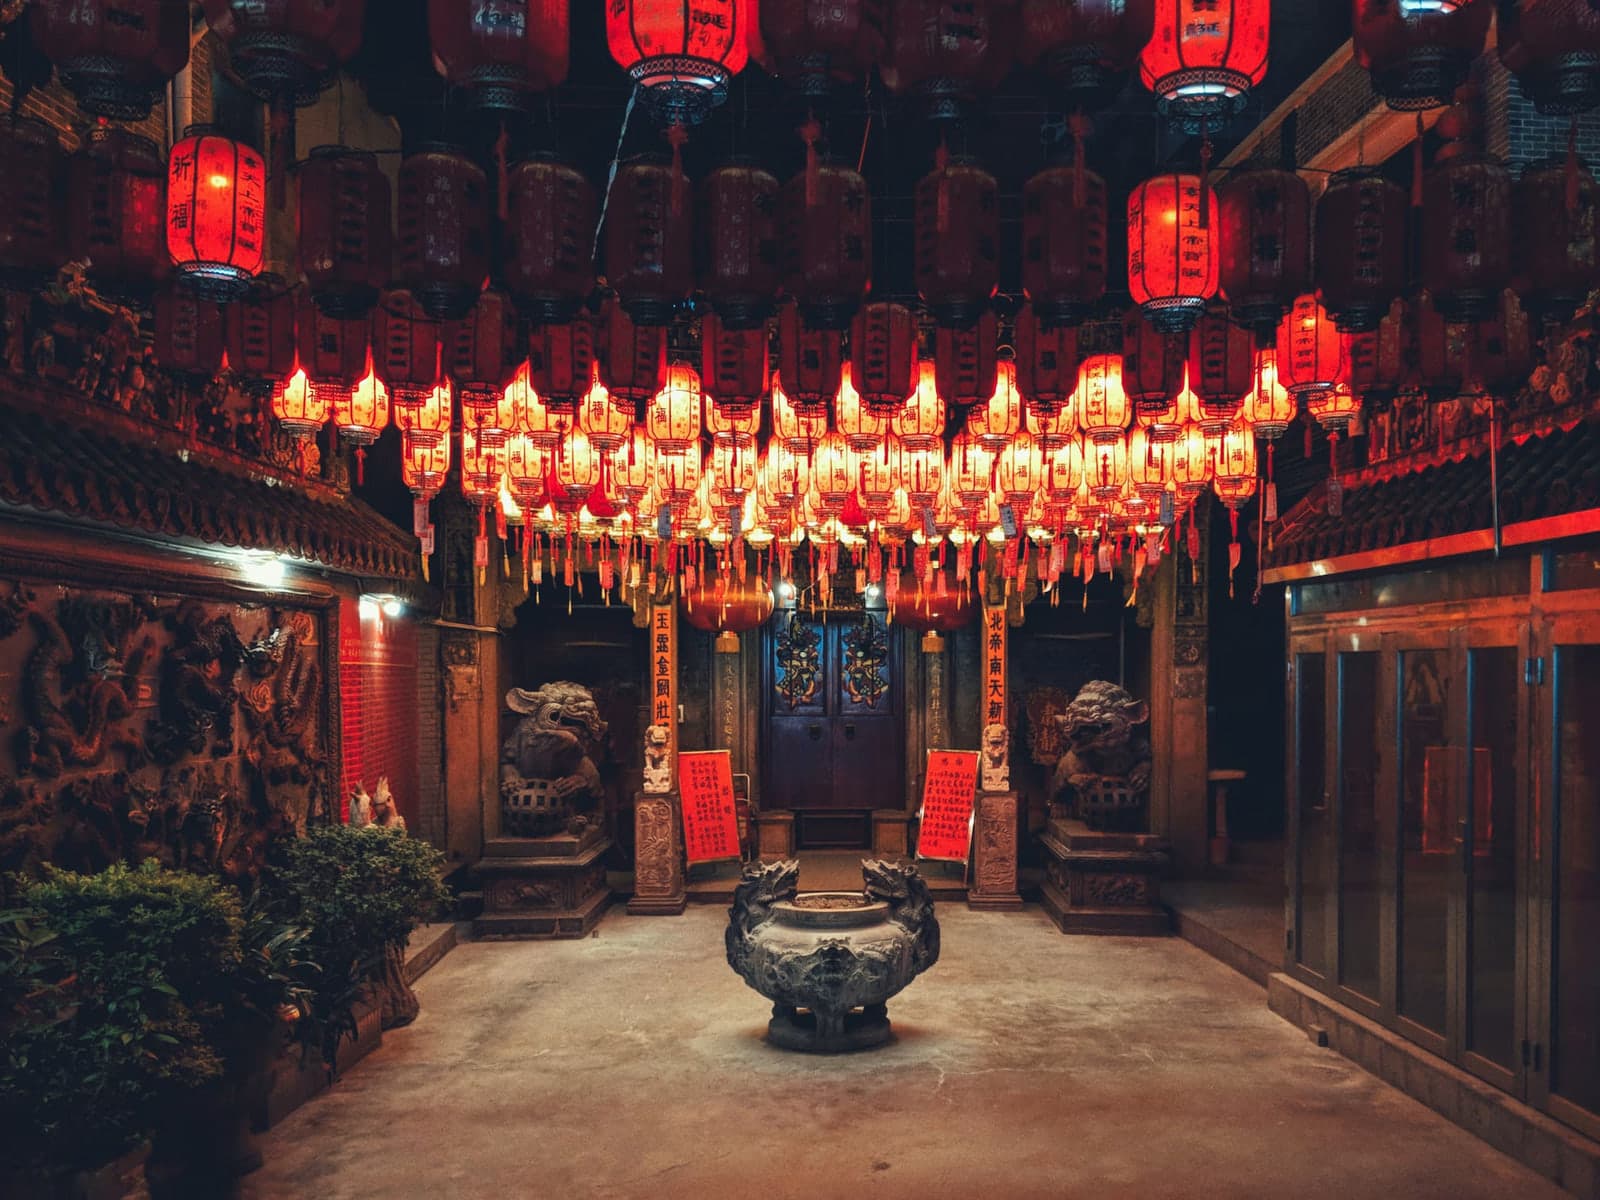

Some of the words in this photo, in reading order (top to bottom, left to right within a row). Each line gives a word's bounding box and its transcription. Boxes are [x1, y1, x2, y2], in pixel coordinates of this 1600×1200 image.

[171, 153, 193, 229] 祈福
[591, 400, 604, 416] 福
[655, 407, 668, 423] 福
[903, 405, 918, 421] 福
[1055, 462, 1067, 476] 福
[989, 611, 1002, 726] 北帝南天新
